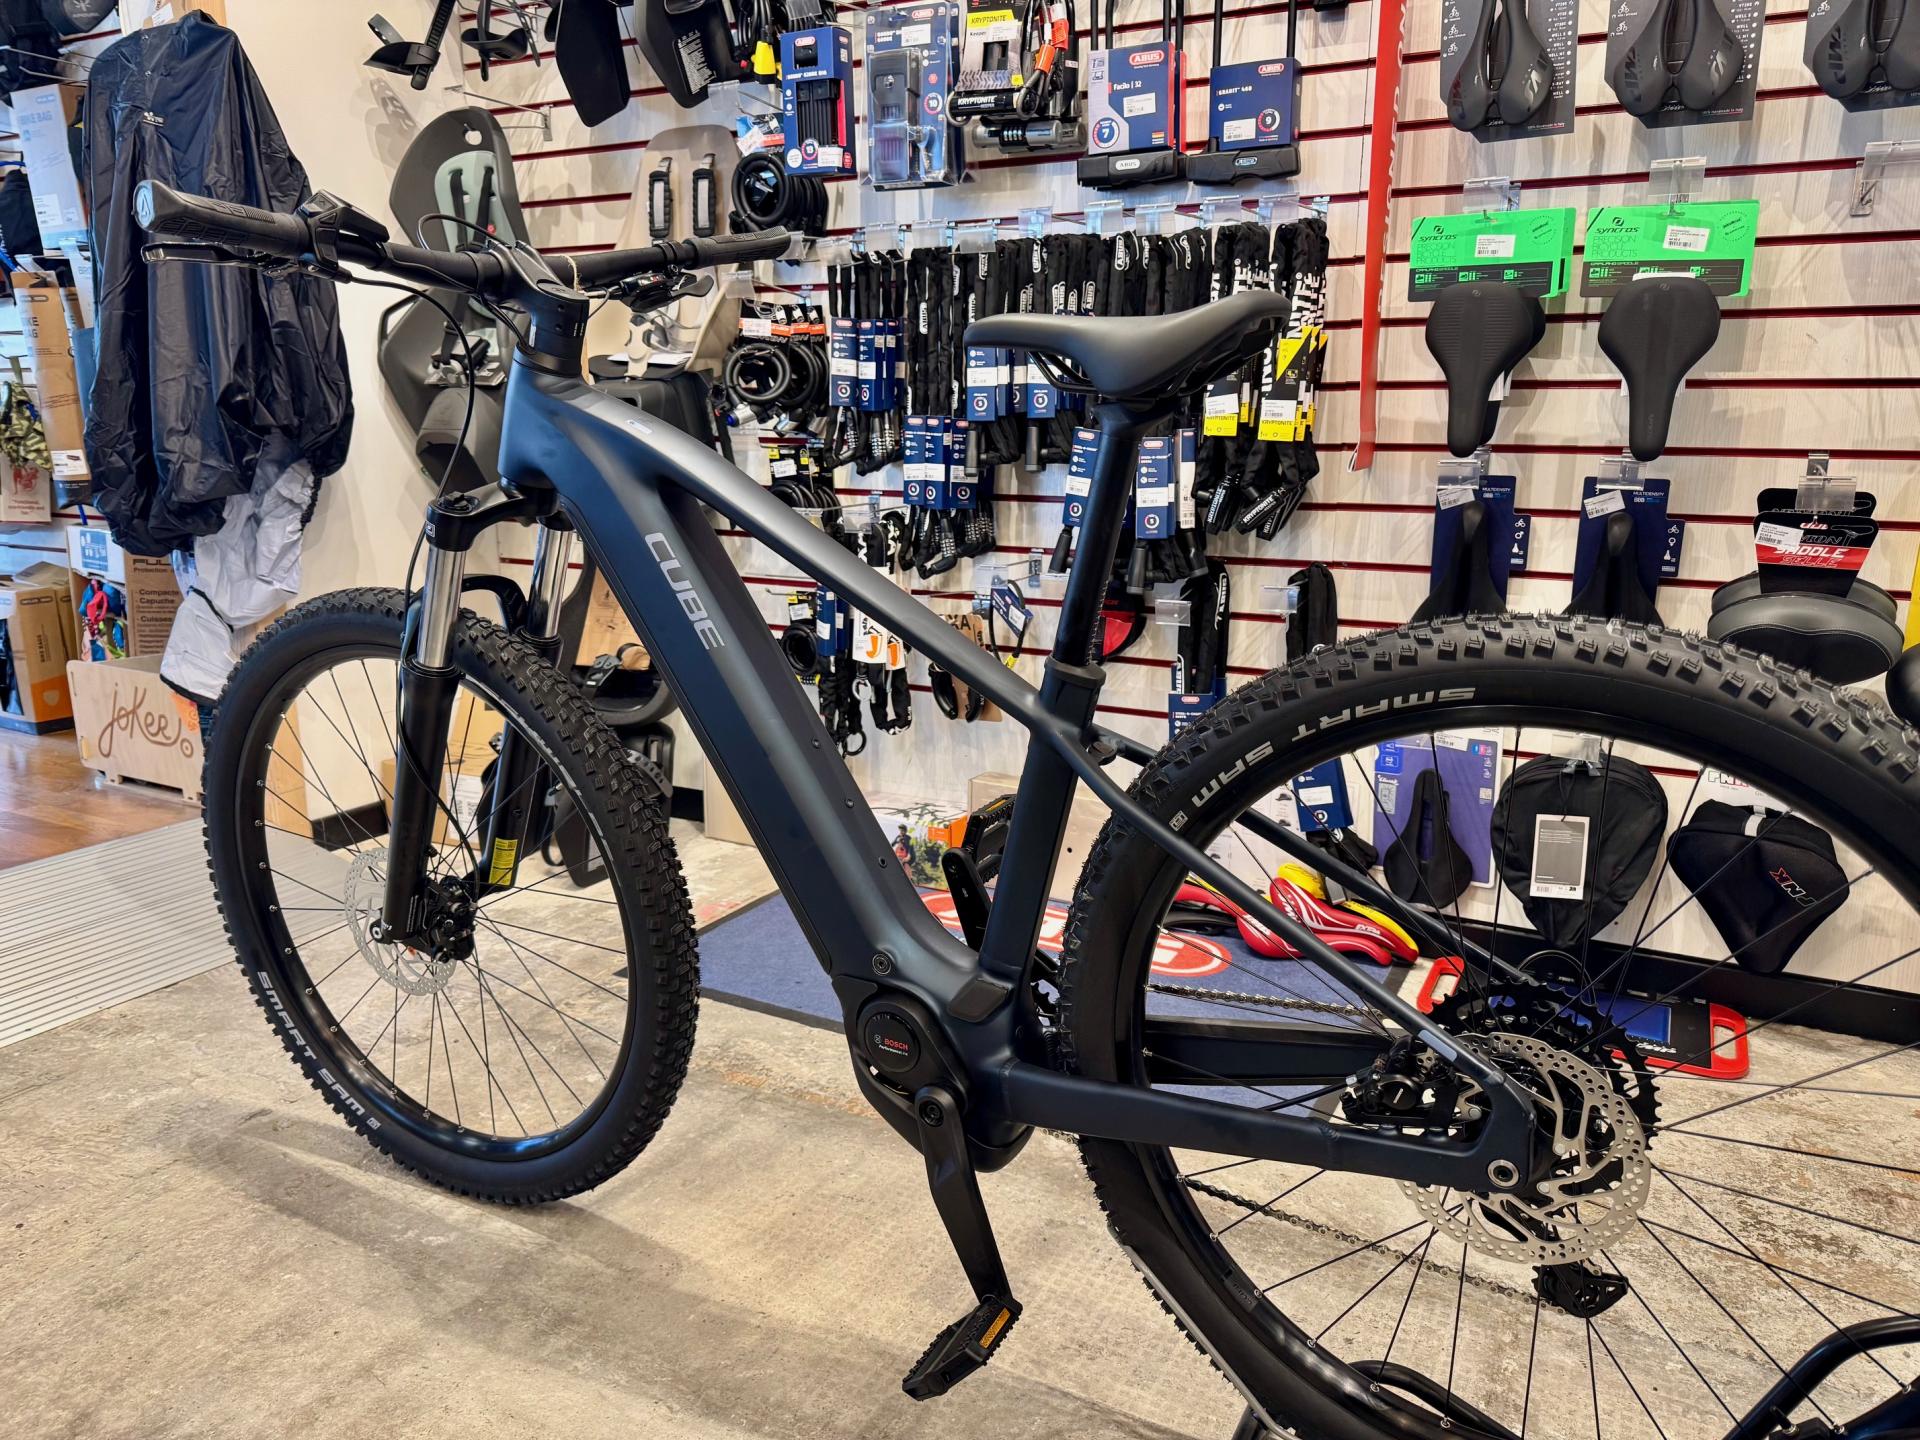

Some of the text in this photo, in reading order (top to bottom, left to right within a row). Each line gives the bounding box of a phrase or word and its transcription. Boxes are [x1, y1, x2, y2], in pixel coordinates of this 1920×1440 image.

[971, 14, 1007, 24] KRYPTONITE
[1132, 53, 1161, 63] ABUS
[1134, 80, 1142, 88] 32
[957, 95, 998, 106] KRYPTONITE
[1265, 116, 1272, 126] 9
[1101, 127, 1110, 139] 7
[1119, 161, 1138, 169] ABUS
[1594, 225, 1641, 235] syncros
[1419, 234, 1457, 243] syncros
[1207, 484, 1223, 523] KRYPTONITE
[1243, 494, 1274, 524] KRYPTONITE
[139, 588, 180, 597] Compacte
[645, 532, 725, 650] CUBE
[139, 597, 175, 605] Capuche
[1191, 687, 1477, 808] SMART SAM
[257, 971, 366, 1116] SMART SAM
[884, 1037, 909, 1052] BOSCH
